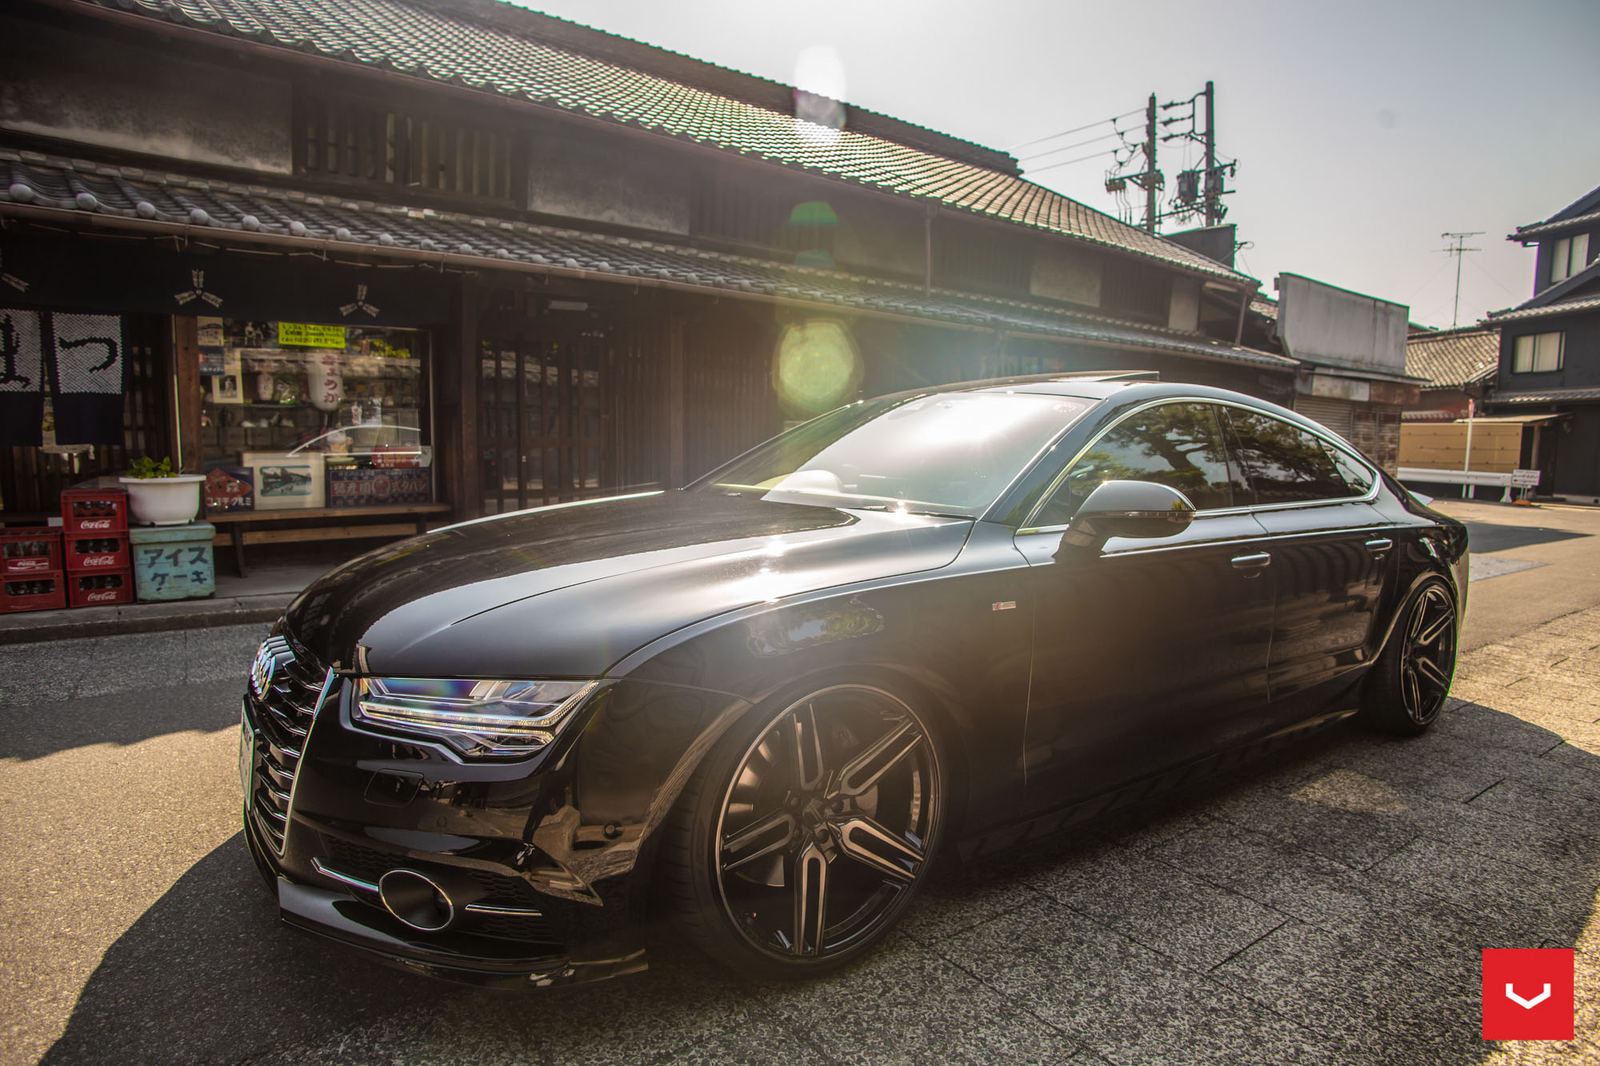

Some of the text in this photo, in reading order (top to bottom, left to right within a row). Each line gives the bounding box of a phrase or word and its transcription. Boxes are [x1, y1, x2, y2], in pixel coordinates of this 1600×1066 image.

[80, 519, 112, 529] Coca-Cola
[83, 555, 115, 566] Coca-Cola
[144, 547, 208, 568] アイス
[151, 570, 207, 592] ケーキ
[87, 591, 117, 602] Coca-Cola
